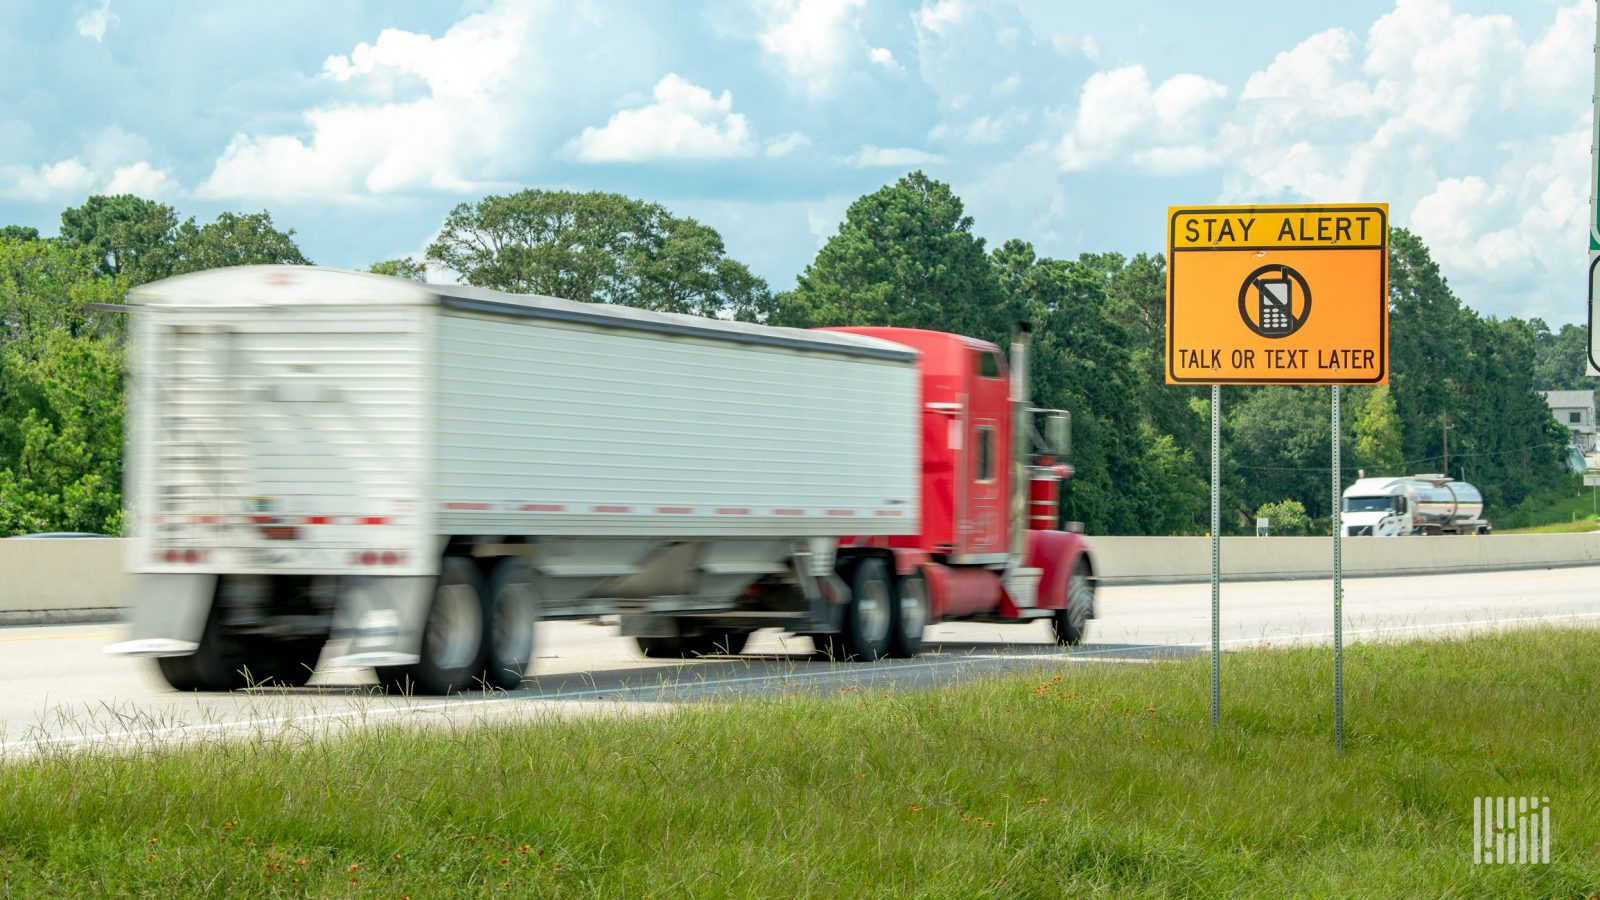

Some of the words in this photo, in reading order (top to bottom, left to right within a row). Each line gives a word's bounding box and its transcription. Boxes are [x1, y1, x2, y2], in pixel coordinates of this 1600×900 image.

[1185, 218, 1256, 243] STAY
[1277, 217, 1371, 241] ALERT
[1179, 349, 1221, 369] TALK
[1231, 349, 1255, 369] OR
[1264, 349, 1309, 369] TEXT
[1318, 349, 1375, 369] LATER
